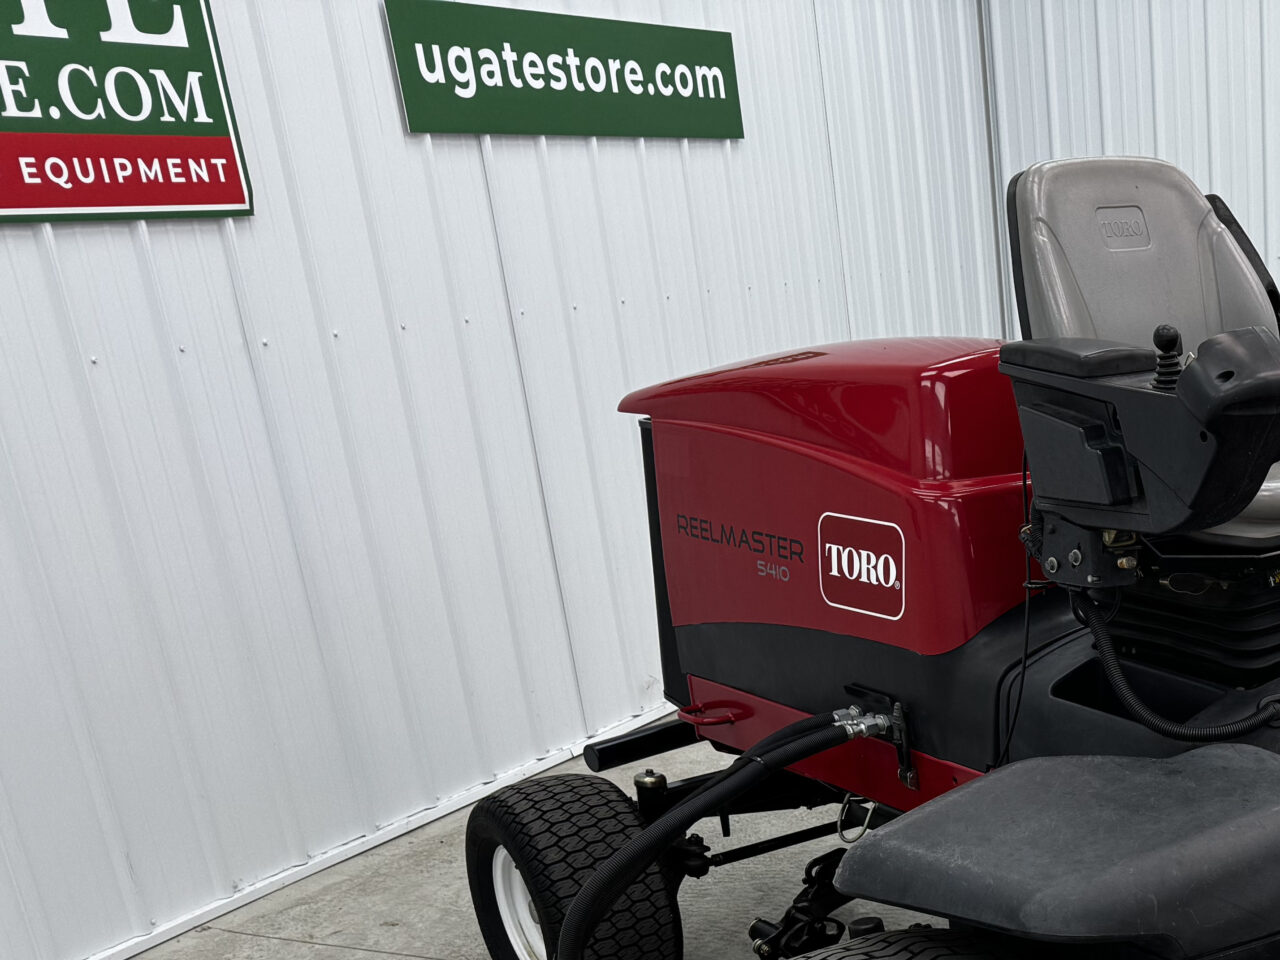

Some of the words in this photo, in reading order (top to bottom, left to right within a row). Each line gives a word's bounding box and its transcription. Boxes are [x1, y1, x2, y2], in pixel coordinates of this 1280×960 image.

[414, 42, 726, 99] ugatestore.com
[0, 60, 214, 123] E.COM
[18, 156, 227, 189] EQUIPMENT
[1101, 220, 1144, 238] TORO
[676, 514, 805, 563] REELMASTER
[756, 560, 790, 582] 5410
